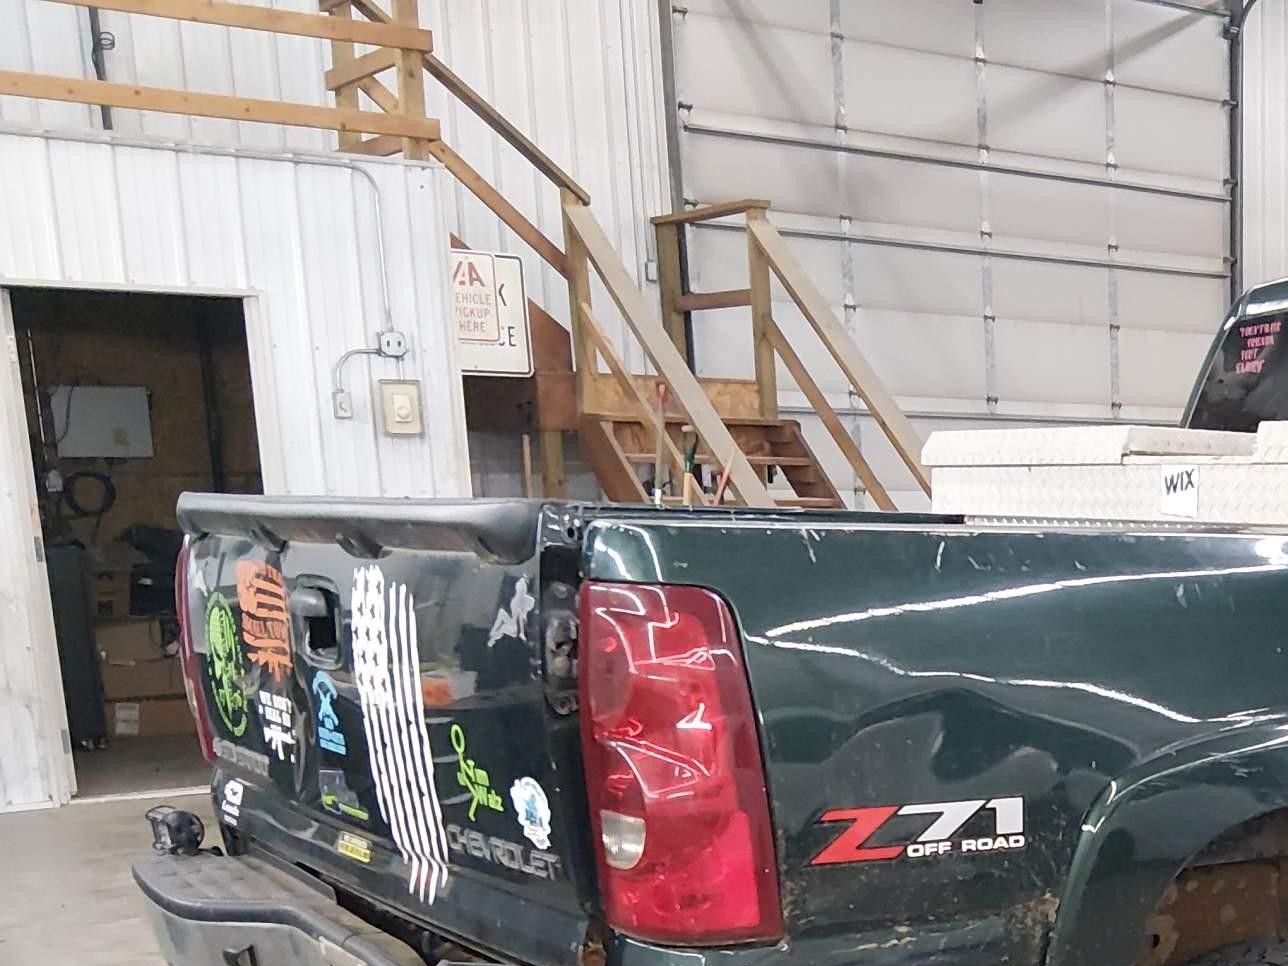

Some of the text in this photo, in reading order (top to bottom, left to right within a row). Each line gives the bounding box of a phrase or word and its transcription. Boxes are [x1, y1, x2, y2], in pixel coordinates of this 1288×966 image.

[455, 292, 491, 306] EHICLE
[455, 306, 490, 319] ICKUP
[459, 320, 486, 333] HERE
[1164, 468, 1195, 496] WIX
[809, 796, 1025, 866] Z71
[446, 823, 561, 881] CHEVROLET
[906, 834, 1026, 859] OFF ROAD
